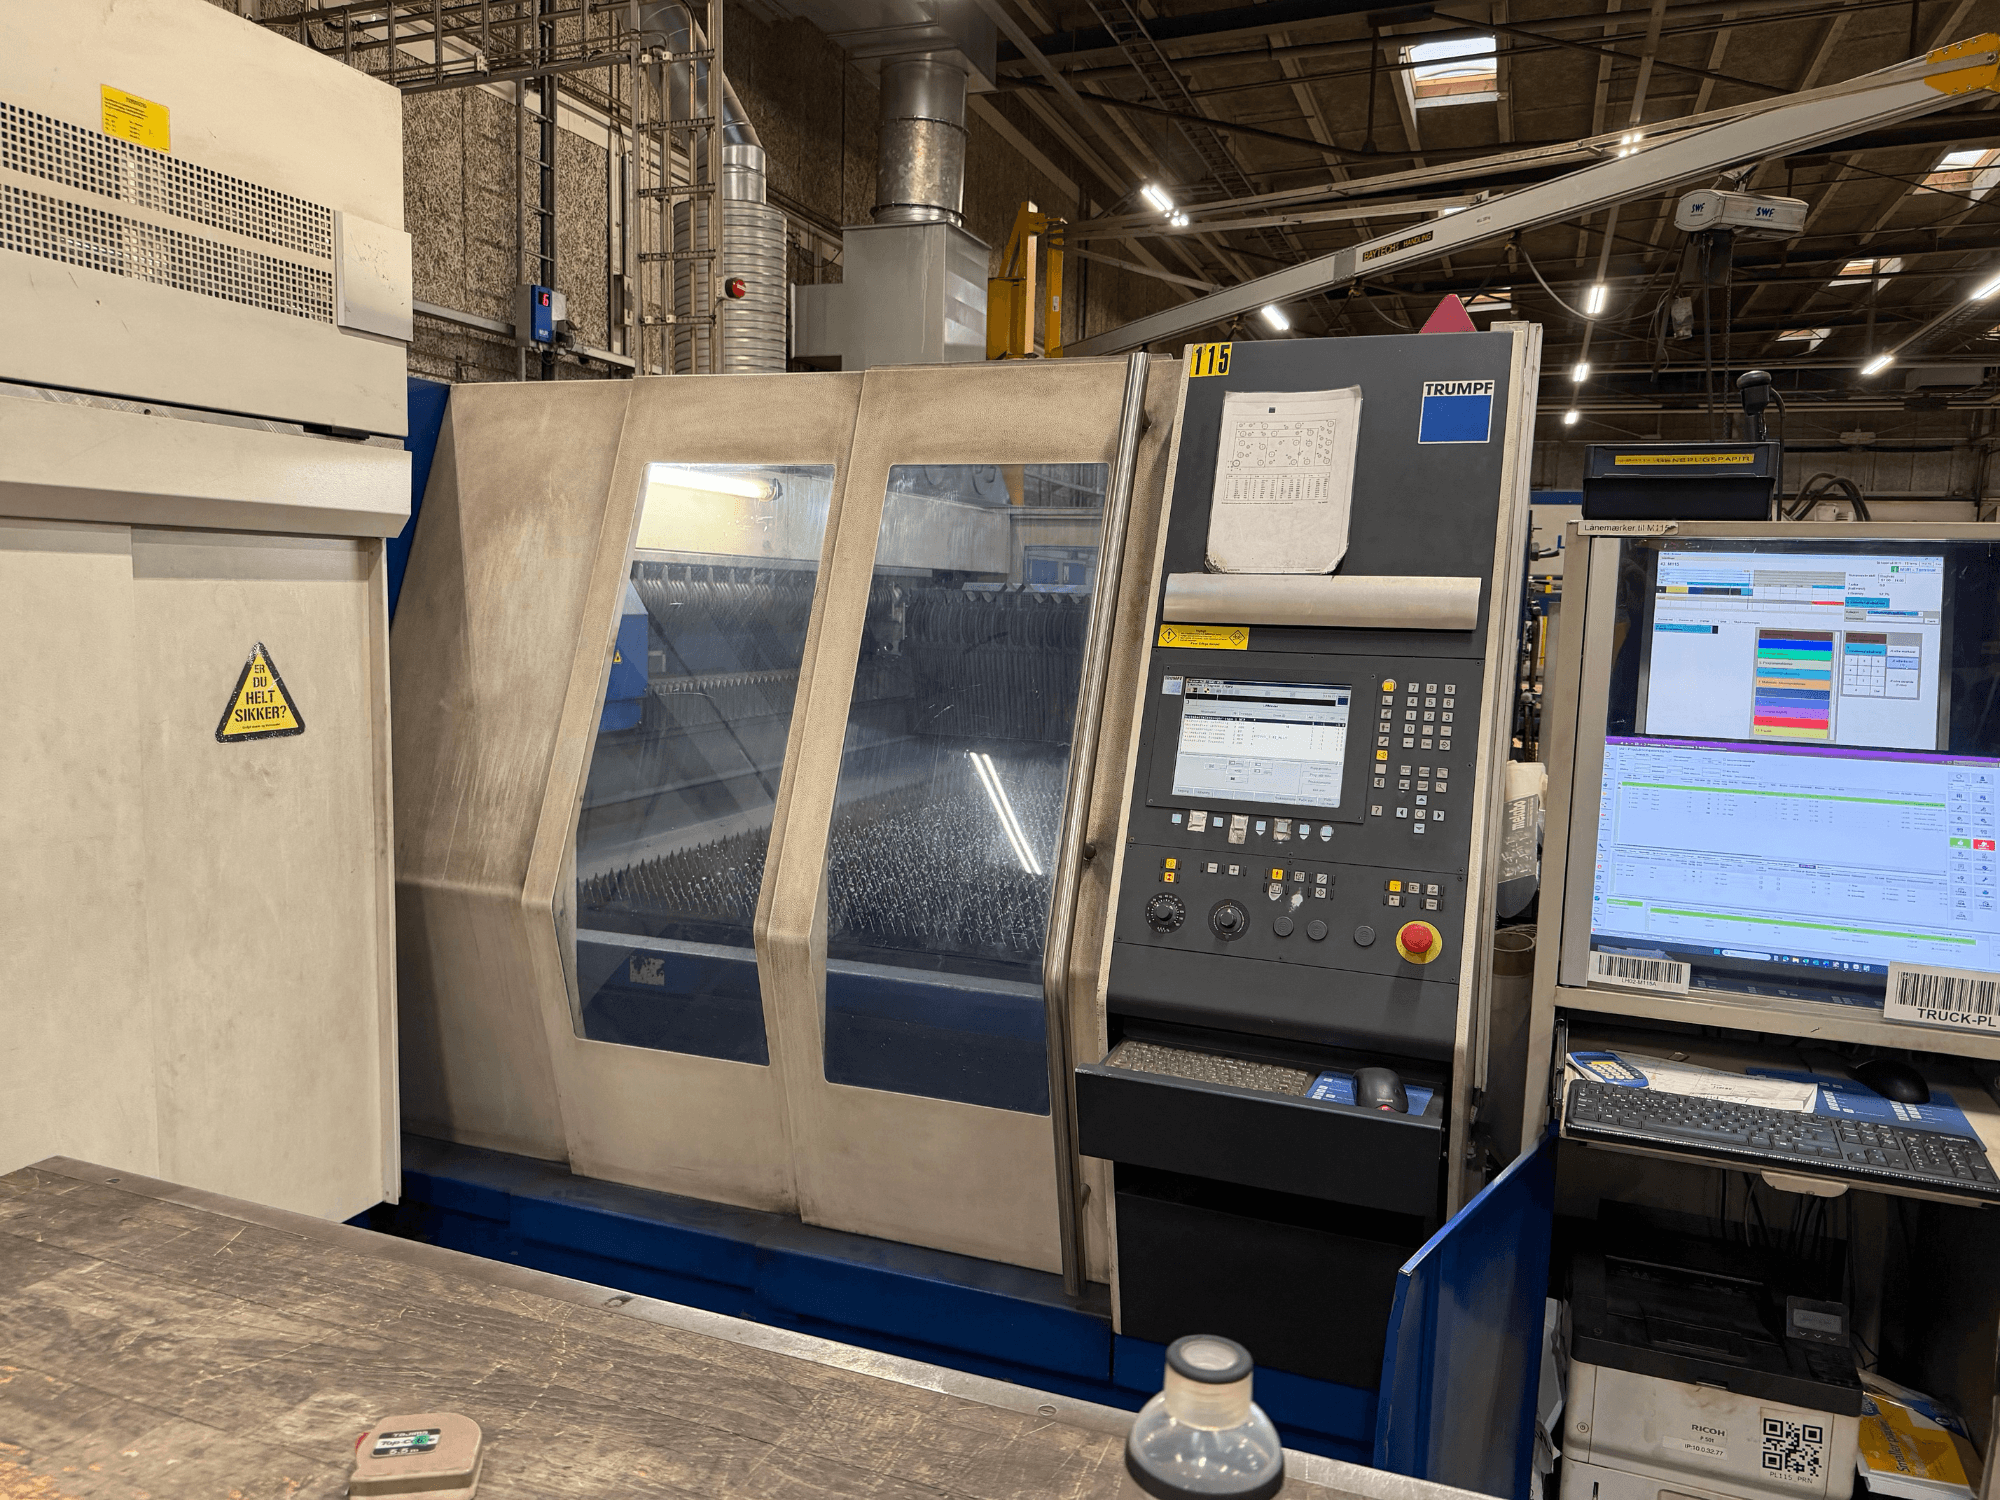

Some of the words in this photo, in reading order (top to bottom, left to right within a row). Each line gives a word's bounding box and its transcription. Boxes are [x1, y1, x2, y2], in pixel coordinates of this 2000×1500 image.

[1691, 203, 1705, 213] SWF
[1756, 207, 1775, 217] SWF
[1195, 345, 1230, 375] 115
[1425, 382, 1493, 396] TRUMPF
[1584, 524, 1635, 532] Lånemærker
[254, 664, 265, 673] ER
[253, 676, 267, 688] DU
[246, 690, 275, 705] HELT
[234, 705, 287, 723] SIKKER?
[1917, 1008, 1997, 1027] TRUCK-PL
[1691, 1424, 1725, 1437] RICOH
[1888, 1444, 1910, 1473] Smaller
[1769, 1471, 1813, 1484] PL115_PRN
